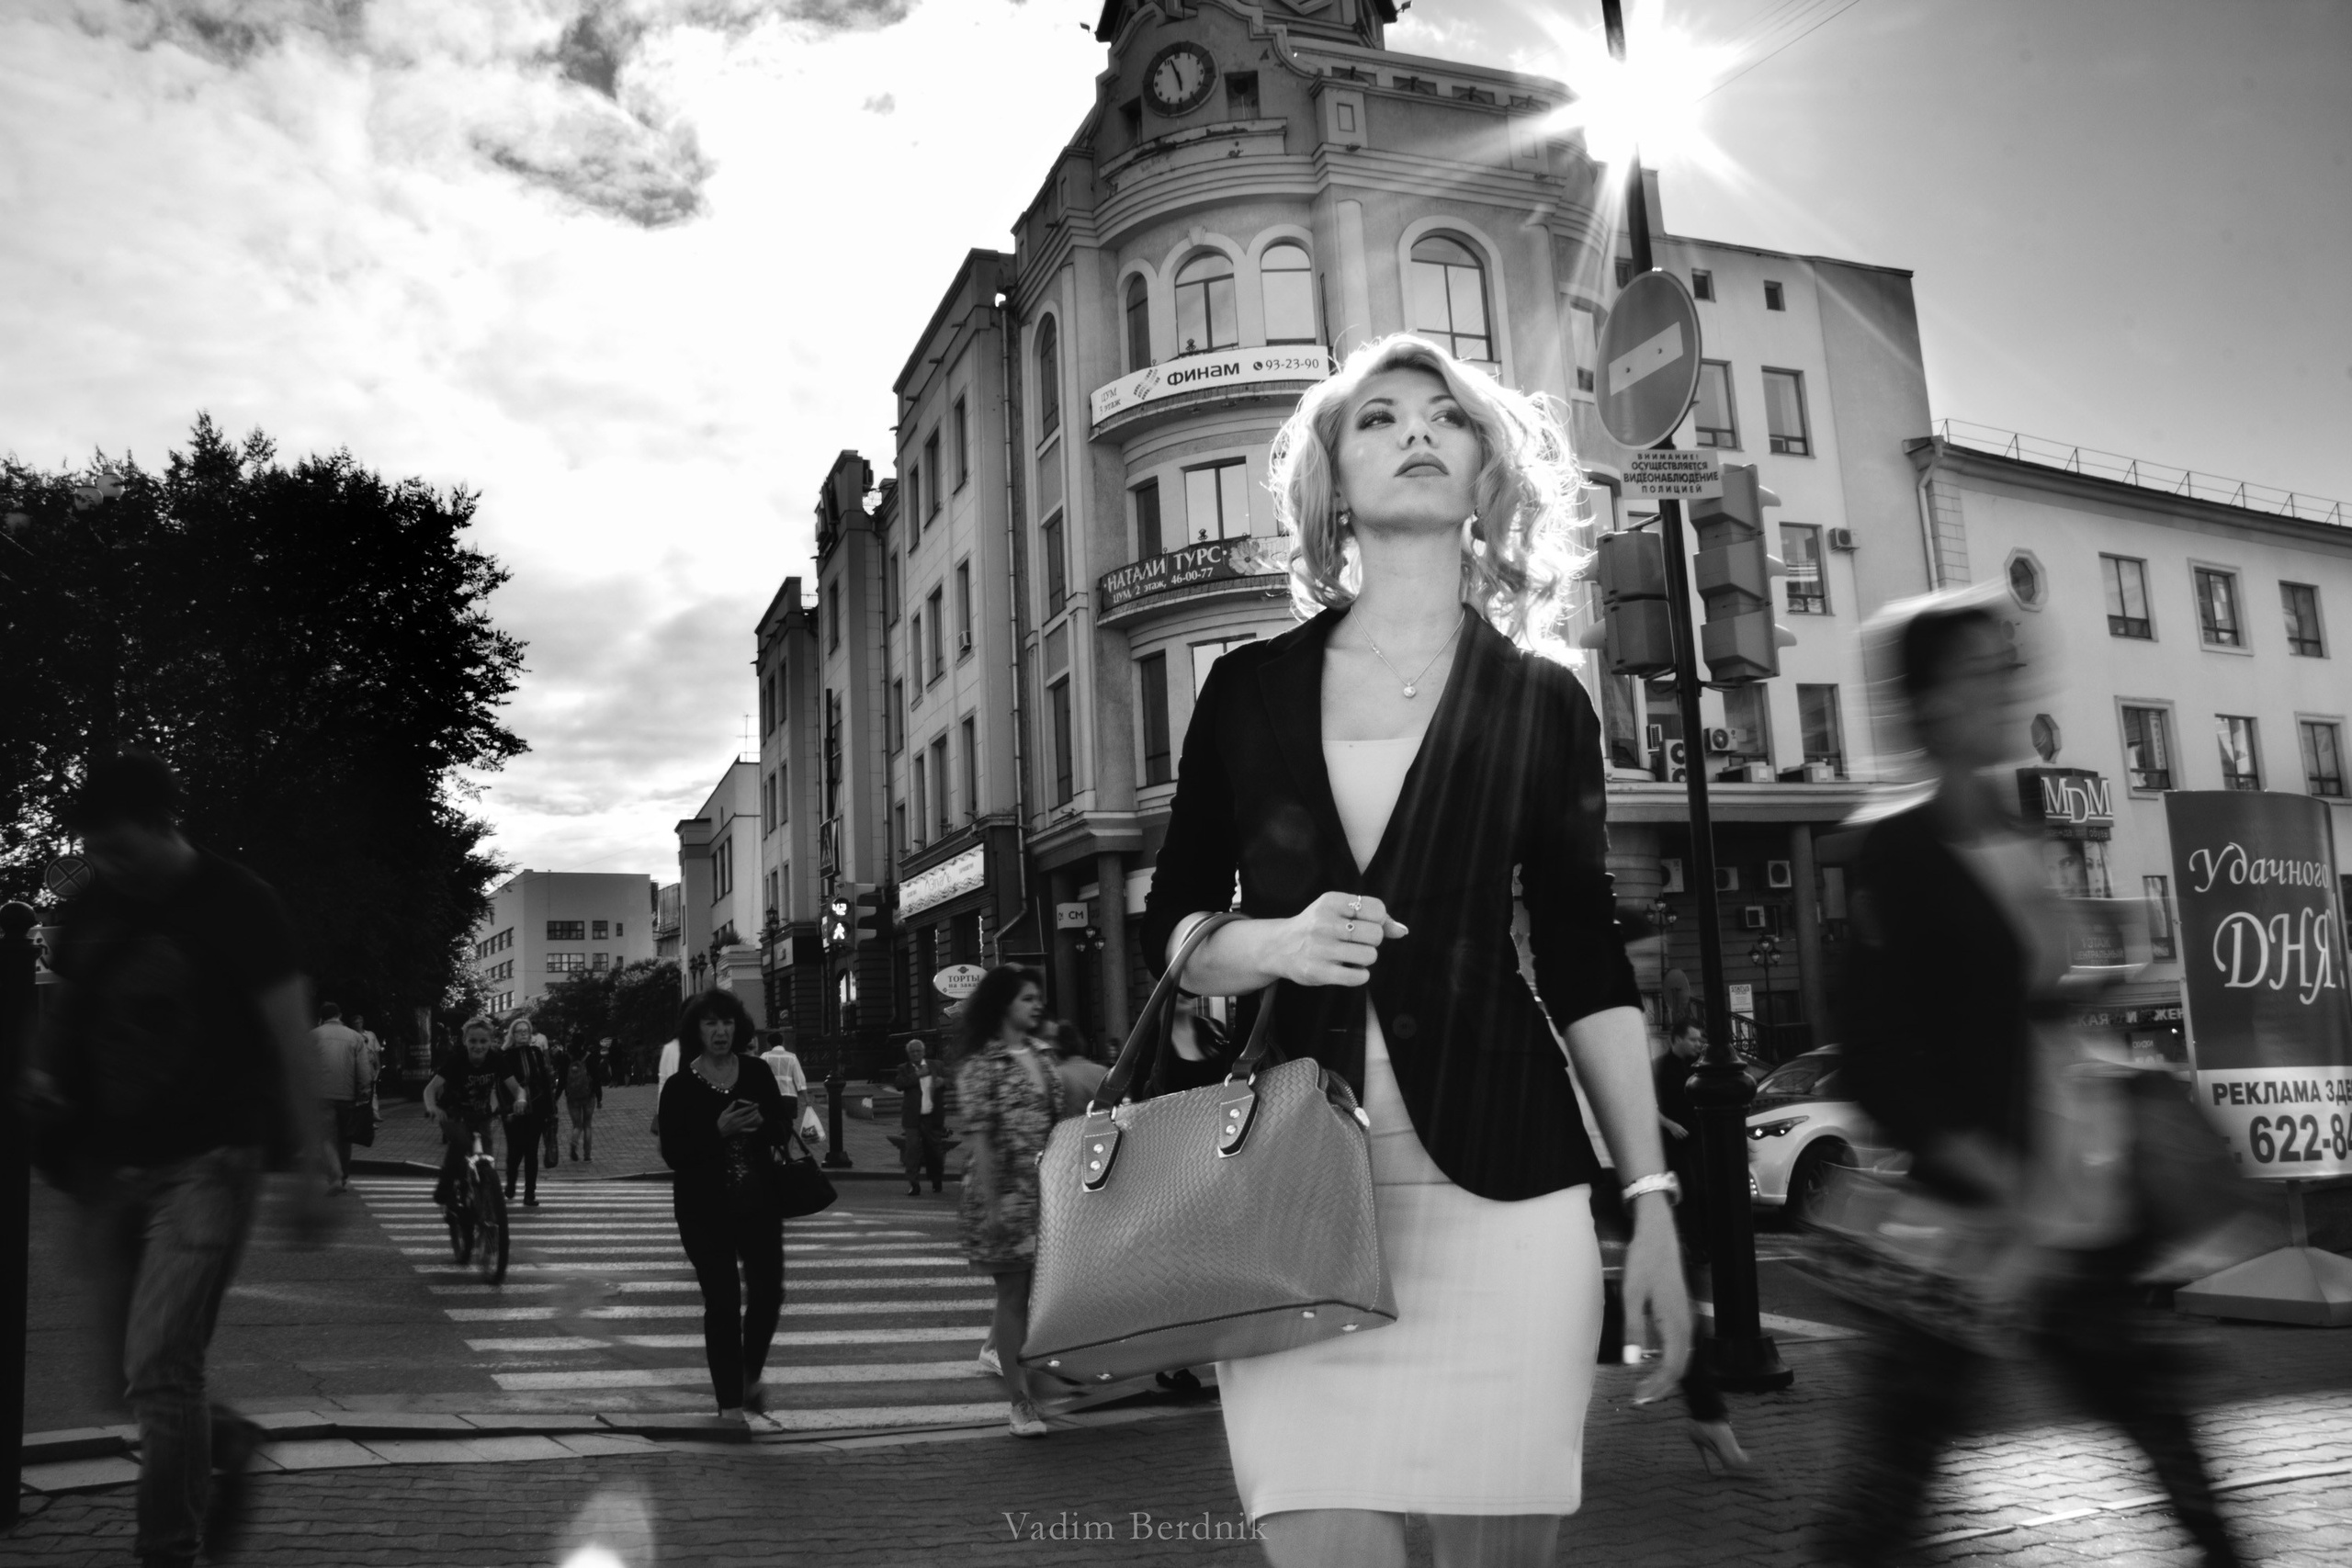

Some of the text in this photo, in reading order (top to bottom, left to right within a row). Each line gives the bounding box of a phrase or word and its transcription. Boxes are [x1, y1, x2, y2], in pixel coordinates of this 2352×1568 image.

[1265, 358, 1319, 370] 93-23-90
[1631, 461, 1708, 471] ОСУЩЕСТВЛЯЕТСЯ
[1623, 471, 1719, 484] ВИДЕОНАБЛЮДЕНИЕ
[1641, 484, 1702, 493] ПОЛИЦИЕЙ
[1173, 546, 1221, 570] ТУРС
[1135, 585, 1141, 595] 2
[1170, 568, 1214, 585] 46-00-77
[2041, 777, 2112, 824] MDM
[2188, 841, 2329, 893] Удачного
[948, 975, 980, 983] ТОРТЫ
[2153, 1008, 2184, 1021] ЖЕН
[2211, 1078, 2352, 1106] РЕКЛАМА ЗДЕ
